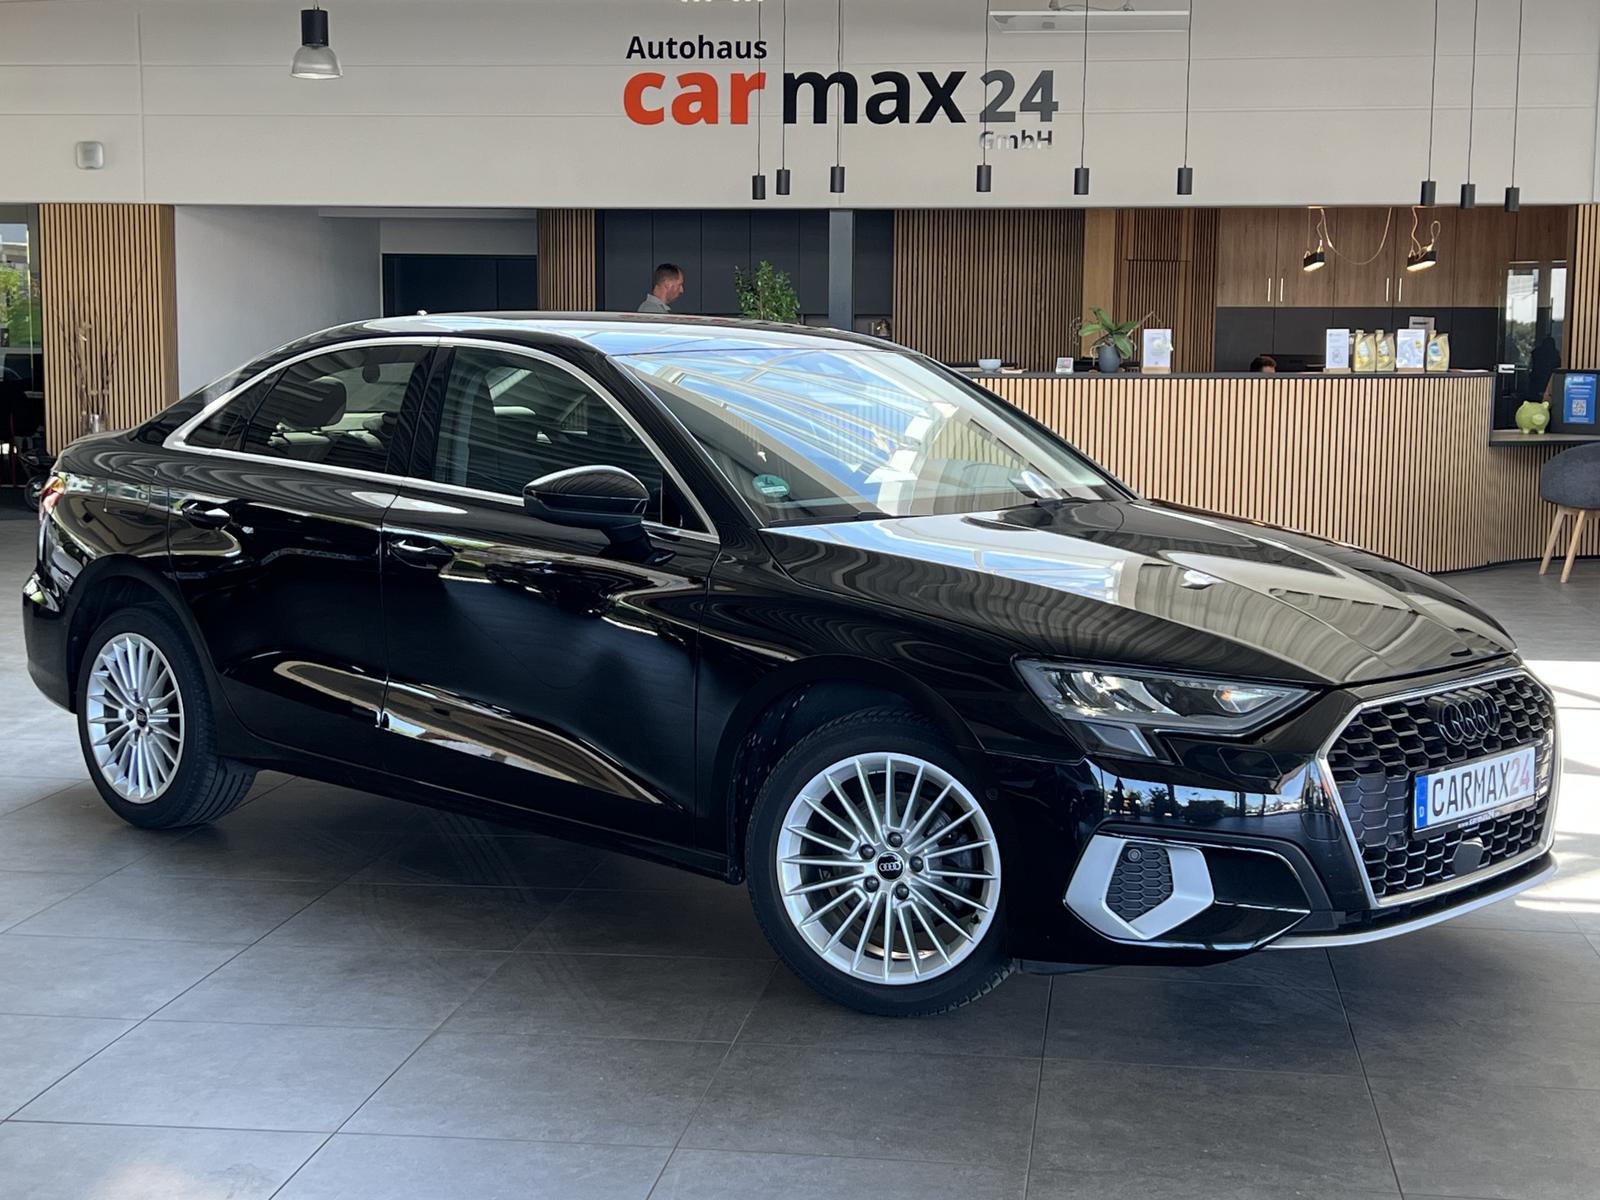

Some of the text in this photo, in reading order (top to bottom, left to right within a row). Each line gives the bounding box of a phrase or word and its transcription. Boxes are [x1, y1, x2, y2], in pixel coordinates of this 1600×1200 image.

[626, 35, 767, 60] Autohaus
[979, 129, 1053, 150] GmbH
[1432, 753, 1530, 816] CARMAX24
